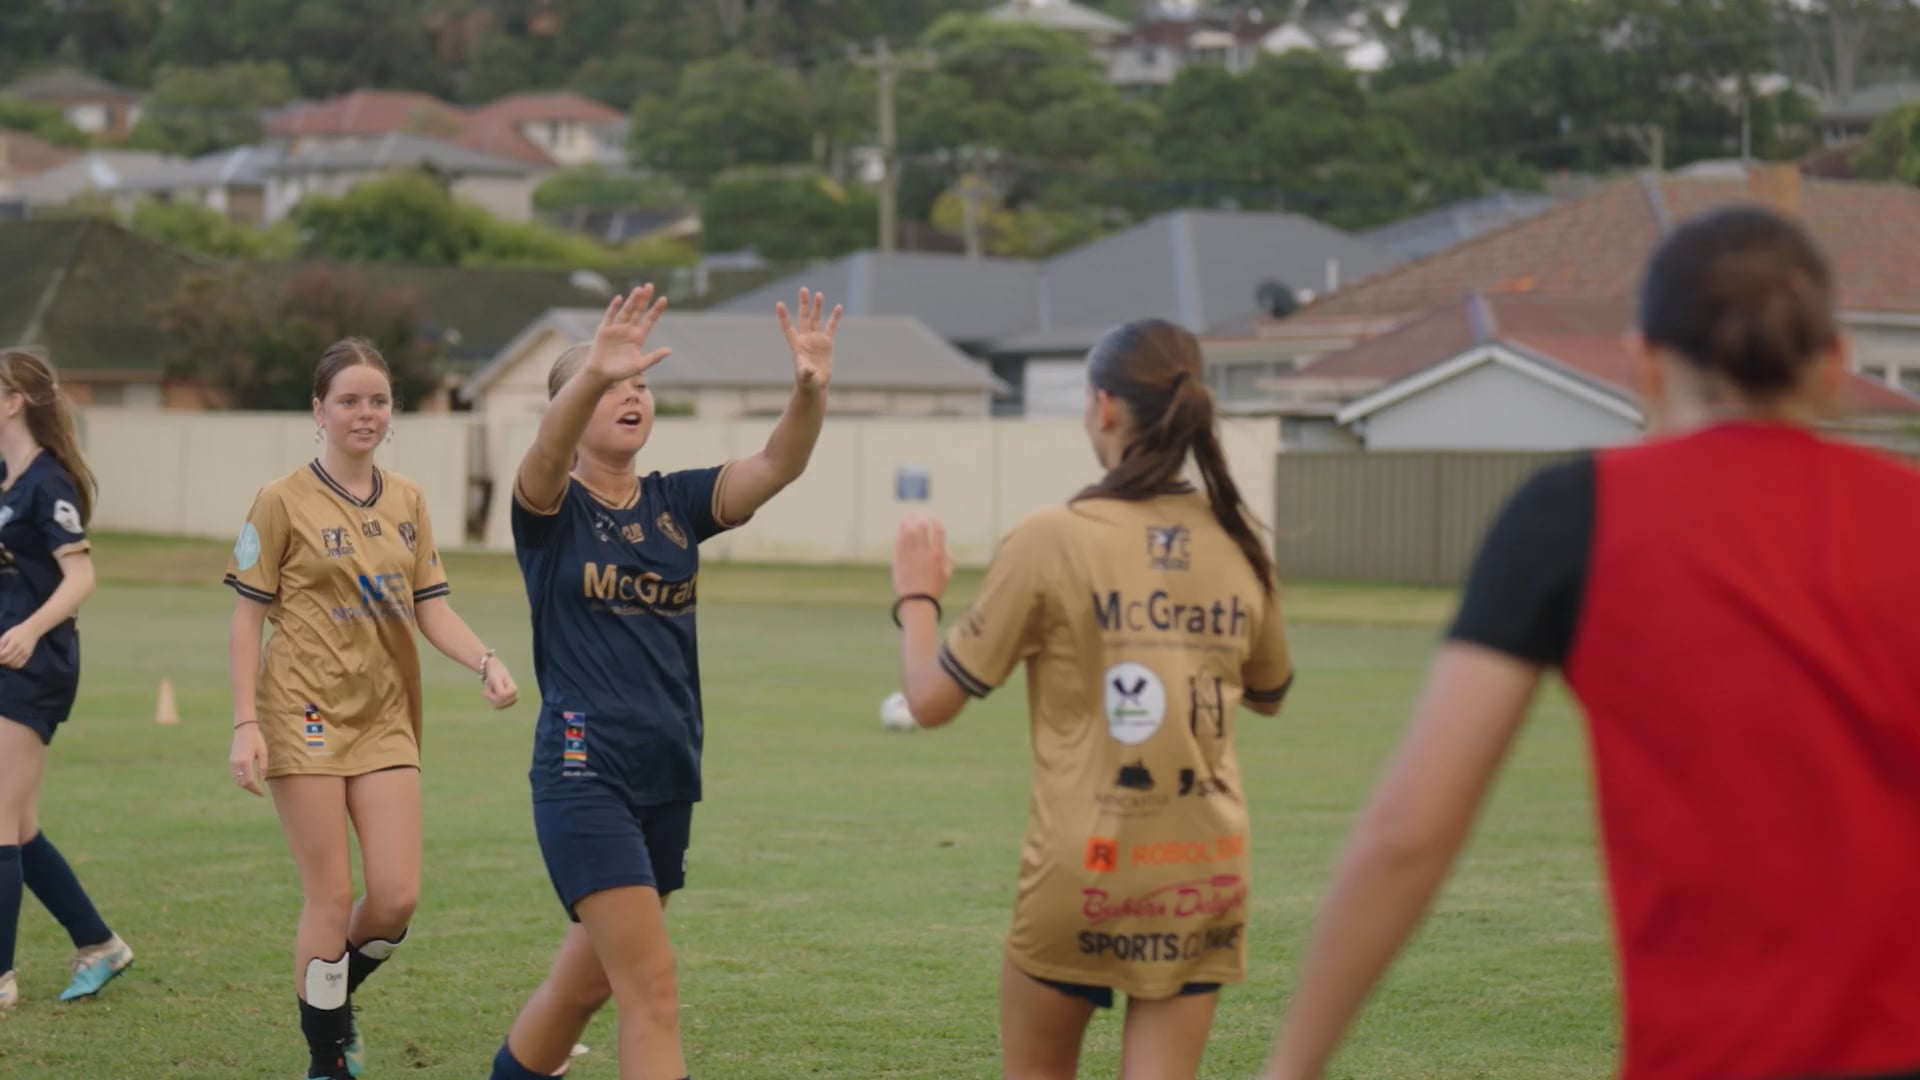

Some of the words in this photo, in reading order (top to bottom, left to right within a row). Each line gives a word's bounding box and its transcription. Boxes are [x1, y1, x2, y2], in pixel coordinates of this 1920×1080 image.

[583, 561, 697, 605] McGra
[1091, 588, 1247, 637] McGrath
[1078, 929, 1180, 961] SPORTS
